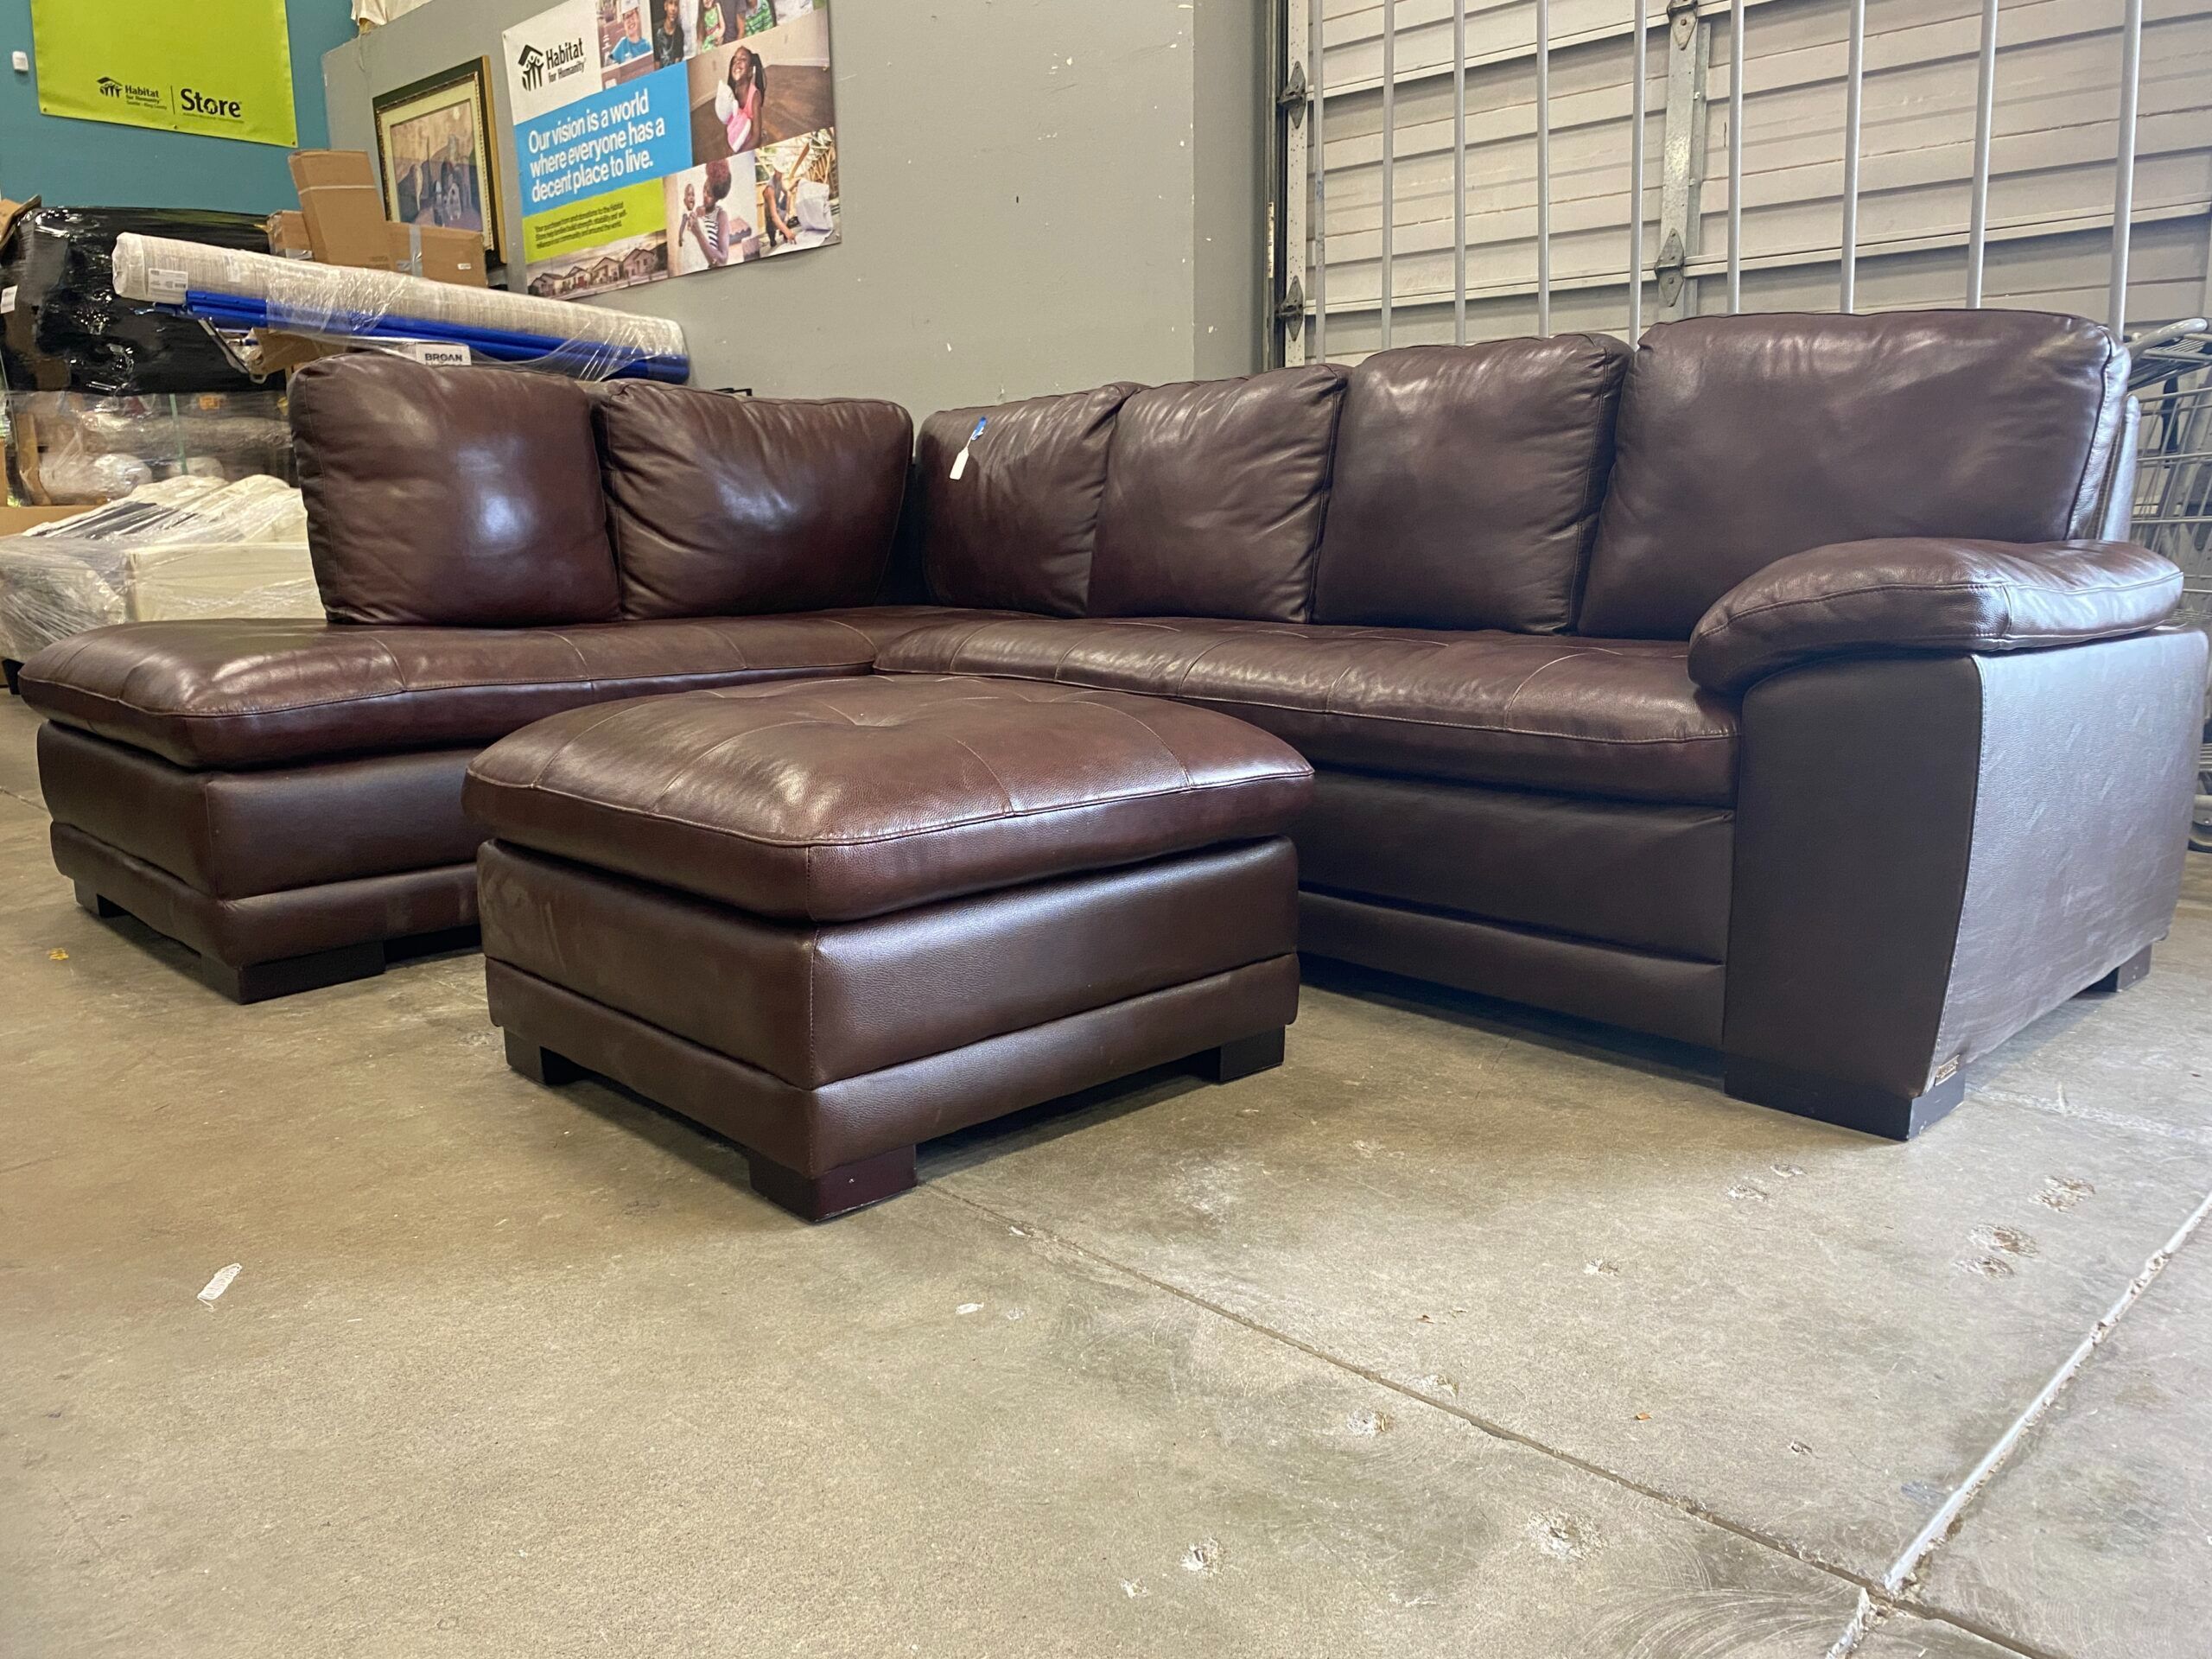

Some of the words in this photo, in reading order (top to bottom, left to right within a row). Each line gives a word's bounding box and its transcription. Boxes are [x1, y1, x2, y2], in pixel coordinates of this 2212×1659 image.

[546, 38, 583, 70] Habitat
[124, 85, 159, 98] Habitat
[180, 88, 241, 118] Store
[528, 130, 550, 154] Our
[551, 116, 586, 145] vision
[586, 108, 600, 132] is
[601, 109, 609, 130] a
[609, 87, 649, 124] world
[530, 153, 567, 178] where
[568, 130, 627, 166] everyone
[627, 121, 654, 146] has
[655, 117, 665, 137] a
[531, 170, 572, 203] decent
[573, 163, 609, 194] place
[609, 156, 624, 178] to
[625, 148, 653, 174] live.
[424, 353, 463, 362] BROAN
